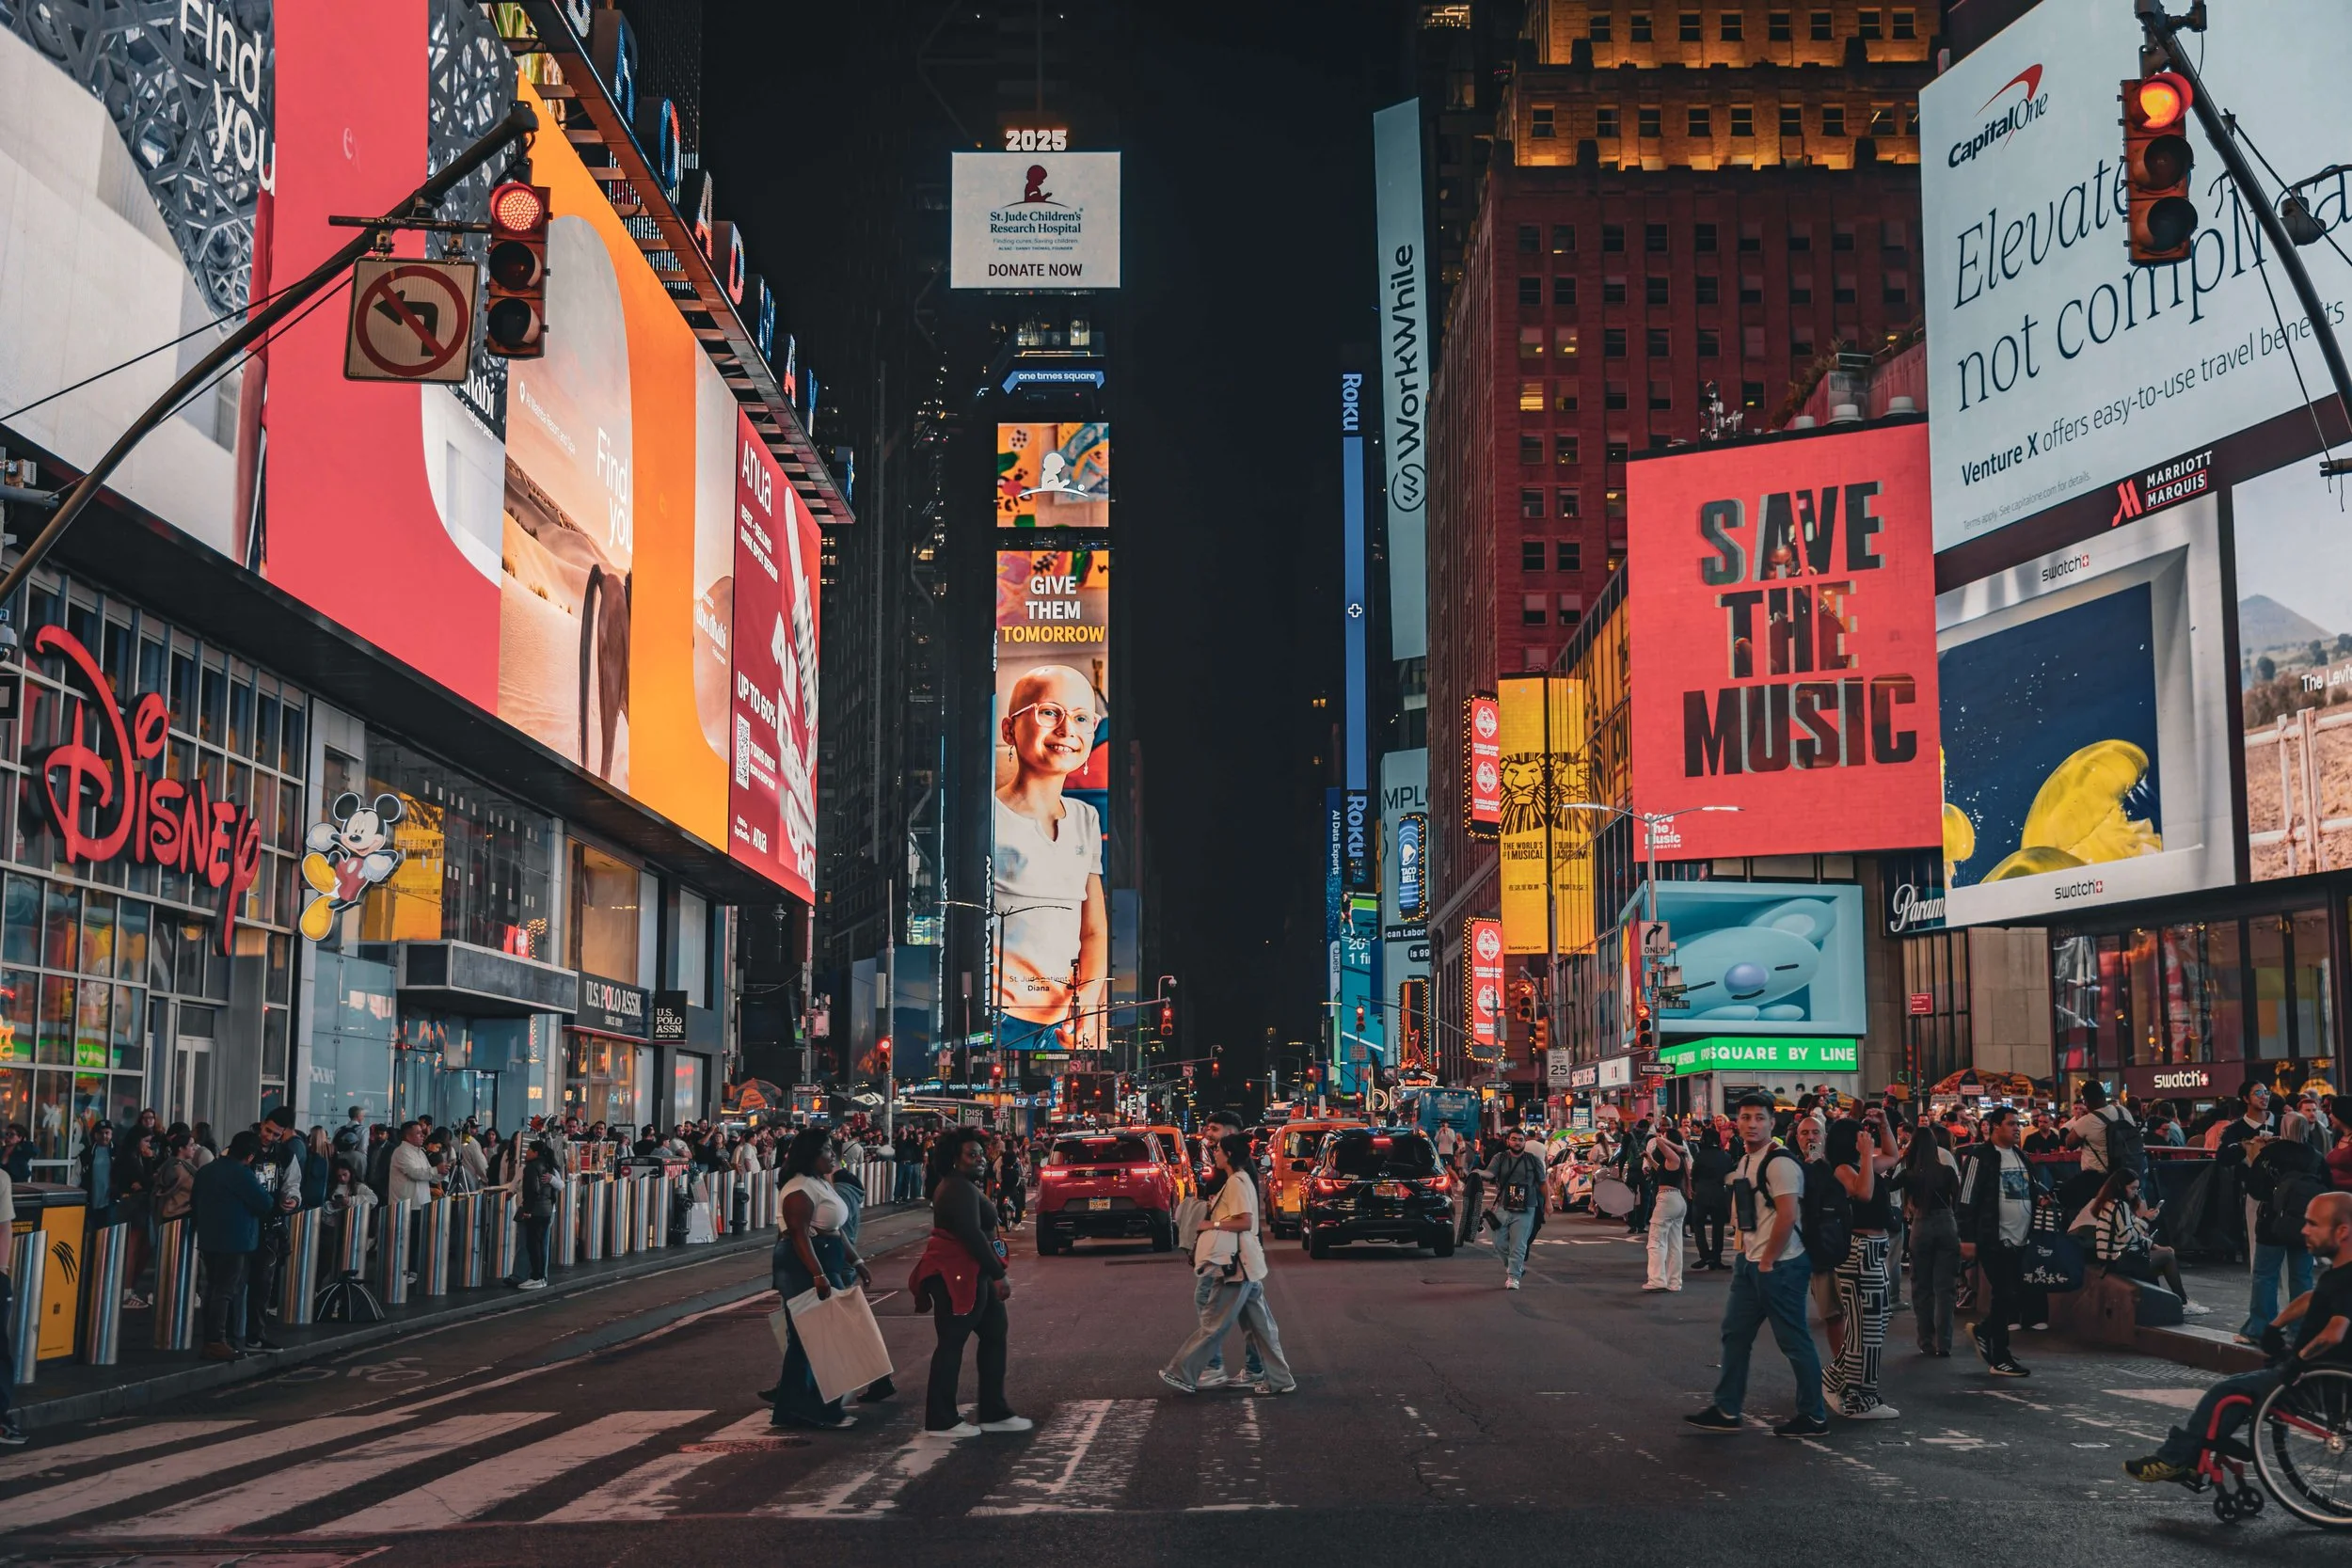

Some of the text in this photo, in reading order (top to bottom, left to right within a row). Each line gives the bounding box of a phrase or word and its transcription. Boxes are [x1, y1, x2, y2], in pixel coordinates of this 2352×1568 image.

[1005, 130, 1067, 151] 2025
[990, 212, 1003, 222] St.
[1005, 212, 1028, 223] Jude
[990, 223, 1081, 235] Research Hospital
[988, 263, 1083, 277] DONATE NOW
[1958, 314, 2041, 412] not
[1063, 372, 1096, 382] square
[1962, 443, 2024, 487] Venture
[2026, 431, 2040, 460] X
[2042, 412, 2090, 453] offers
[2092, 368, 2196, 430] easy-to-use
[2201, 331, 2255, 382] travel
[597, 427, 628, 506] Find
[2146, 450, 2213, 488] MARRIOTT
[2147, 473, 2205, 508] MARQUIS
[1699, 480, 1886, 587] SAVE
[2042, 556, 2082, 582] swatch
[1030, 575, 1077, 595] GIVE
[1025, 600, 1081, 620] THEM
[1001, 626, 1105, 642] TOMORROW
[1715, 579, 1859, 680] THE
[2301, 673, 2324, 692] The
[738, 671, 776, 730] UP TO 60%
[1683, 673, 1917, 778] MUSIC
[1331, 810, 1341, 875] AI Data Experts
[1511, 849, 1544, 860] MUSICAL
[1401, 866, 1417, 875] TACO
[1402, 875, 1417, 883] BELL
[2054, 879, 2096, 900] swatch
[1890, 883, 1946, 932] Param
[1403, 928, 1426, 938] Labor
[586, 980, 600, 1007] U.S.
[600, 985, 621, 1013] POLO
[656, 1016, 682, 1025] POLO
[657, 1007, 674, 1016] U.S.
[656, 1024, 684, 1034] ASSN.
[1710, 1046, 1777, 1061] SQUARE
[1788, 1047, 1809, 1060] BY
[1820, 1047, 1856, 1061] LINE
[1550, 1065, 1567, 1076] 25
[2153, 1070, 2201, 1088] swatch
